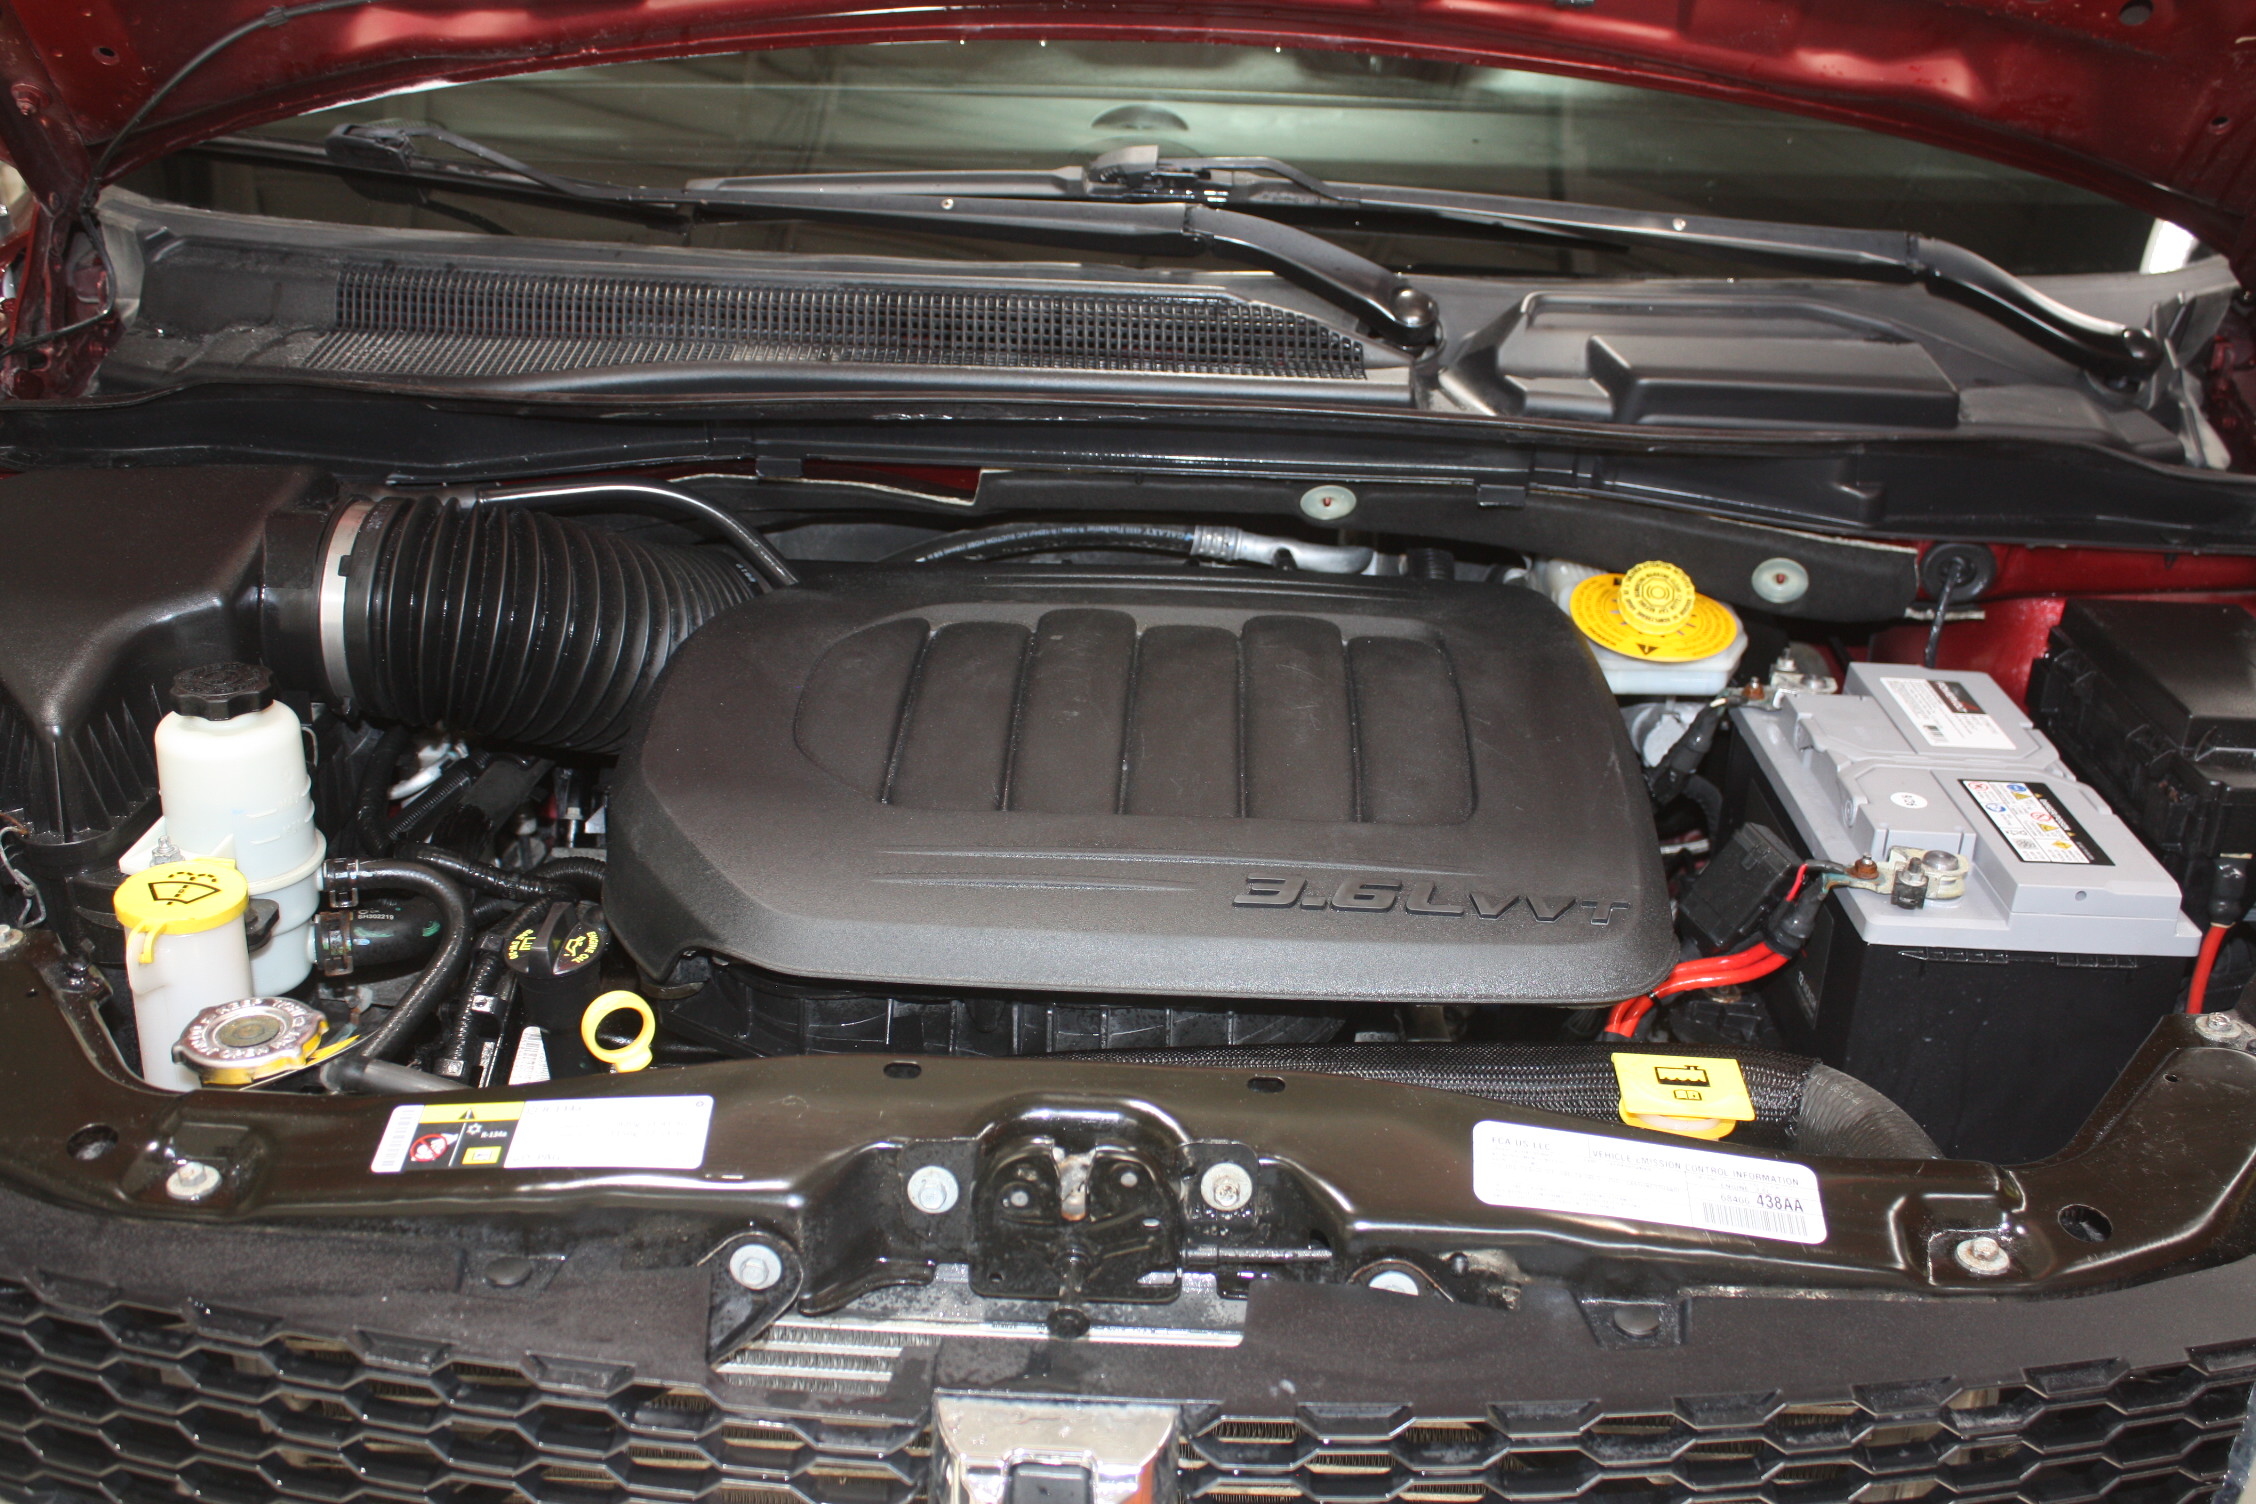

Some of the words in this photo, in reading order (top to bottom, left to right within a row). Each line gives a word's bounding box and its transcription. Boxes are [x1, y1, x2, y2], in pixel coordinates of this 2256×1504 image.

[586, 930, 599, 954] ENGINE
[571, 953, 590, 963] OIL
[1592, 1150, 1632, 1163] VEHICLE
[1635, 1157, 1682, 1170] EMISSION
[1685, 1163, 1729, 1178] CONTROL
[1732, 1170, 1800, 1186] INFORMATION
[1756, 1193, 1804, 1213] 438AA
